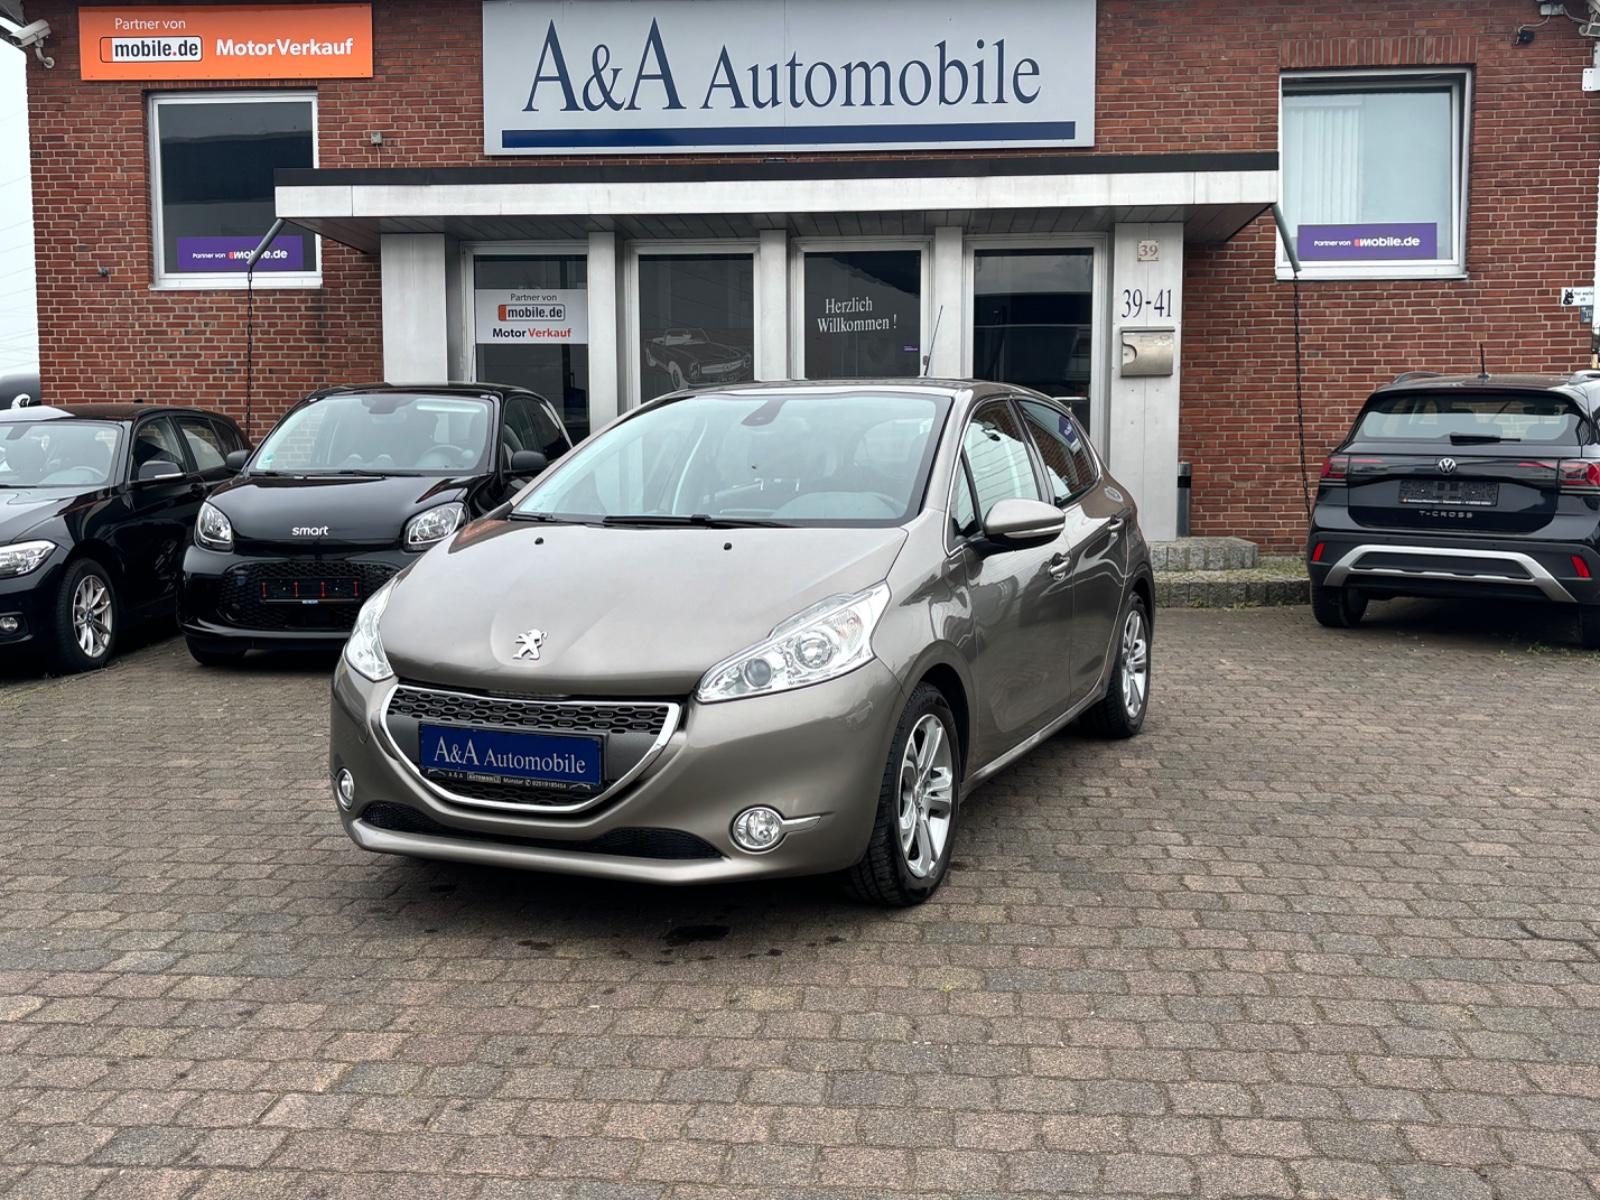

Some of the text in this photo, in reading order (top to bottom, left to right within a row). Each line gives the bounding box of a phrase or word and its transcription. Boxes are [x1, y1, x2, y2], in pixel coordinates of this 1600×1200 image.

[115, 17, 186, 30] Partner von
[114, 39, 199, 57] mobile.de
[522, 17, 1041, 112] A&A Automobile
[1360, 236, 1420, 247] mobile.de
[1139, 245, 1158, 257] 39
[510, 293, 540, 301] Partner
[1121, 288, 1172, 318] 39-41
[825, 296, 873, 314] Herzlich
[507, 306, 563, 318] mobile.de
[817, 316, 889, 333] Willkommen
[1419, 510, 1473, 518] T-CROSS
[291, 525, 329, 538] smart
[433, 735, 586, 775] A&A Automobile
